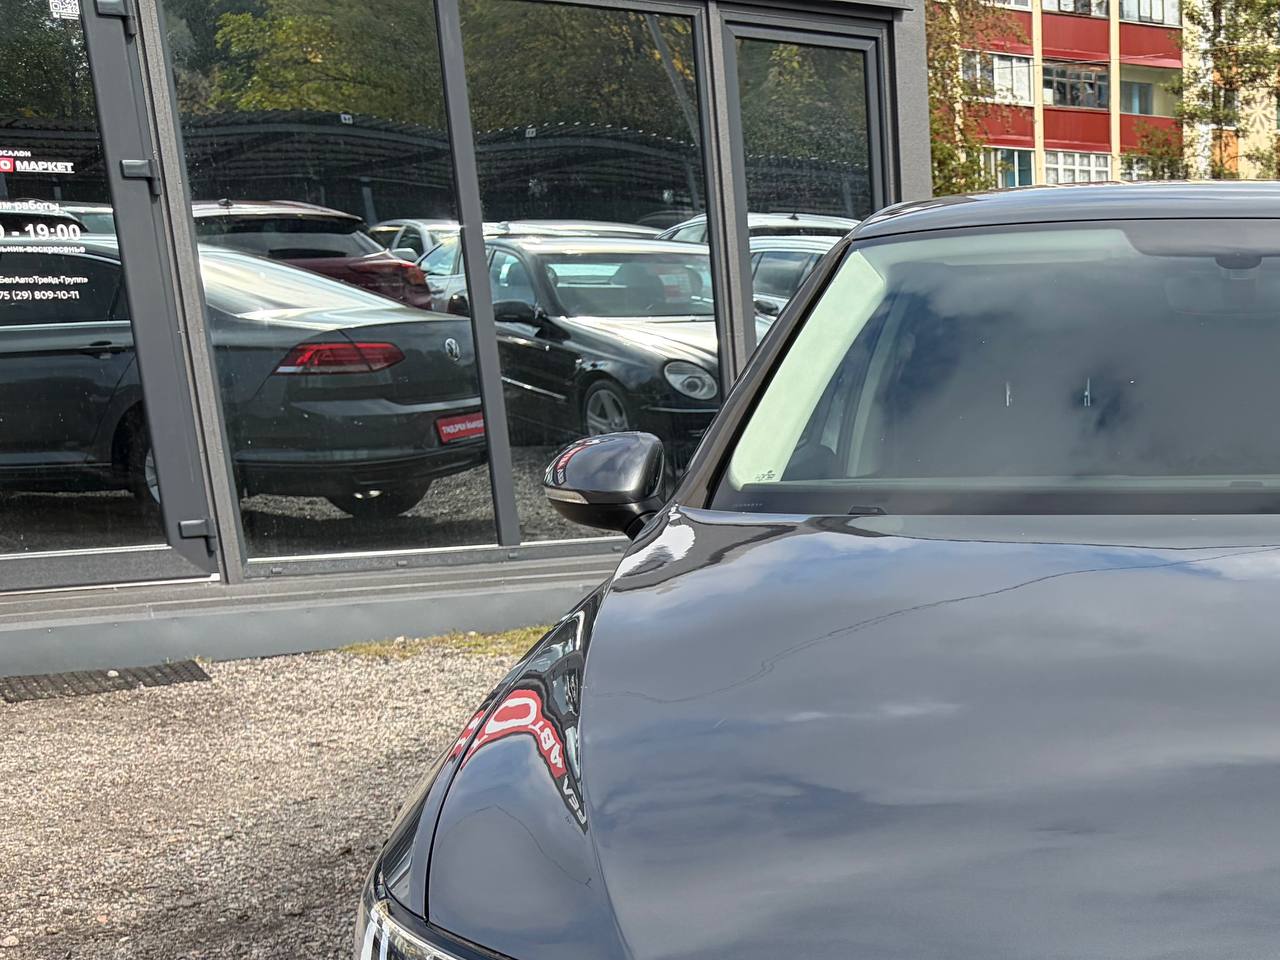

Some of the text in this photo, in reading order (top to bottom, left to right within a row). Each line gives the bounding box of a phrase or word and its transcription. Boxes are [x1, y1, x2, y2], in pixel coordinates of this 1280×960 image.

[15, 161, 74, 171] МАРКЕТ
[15, 200, 60, 212] работы
[25, 223, 80, 240] 19:00
[12, 290, 32, 300] (29)
[34, 290, 80, 300] 809-10-11
